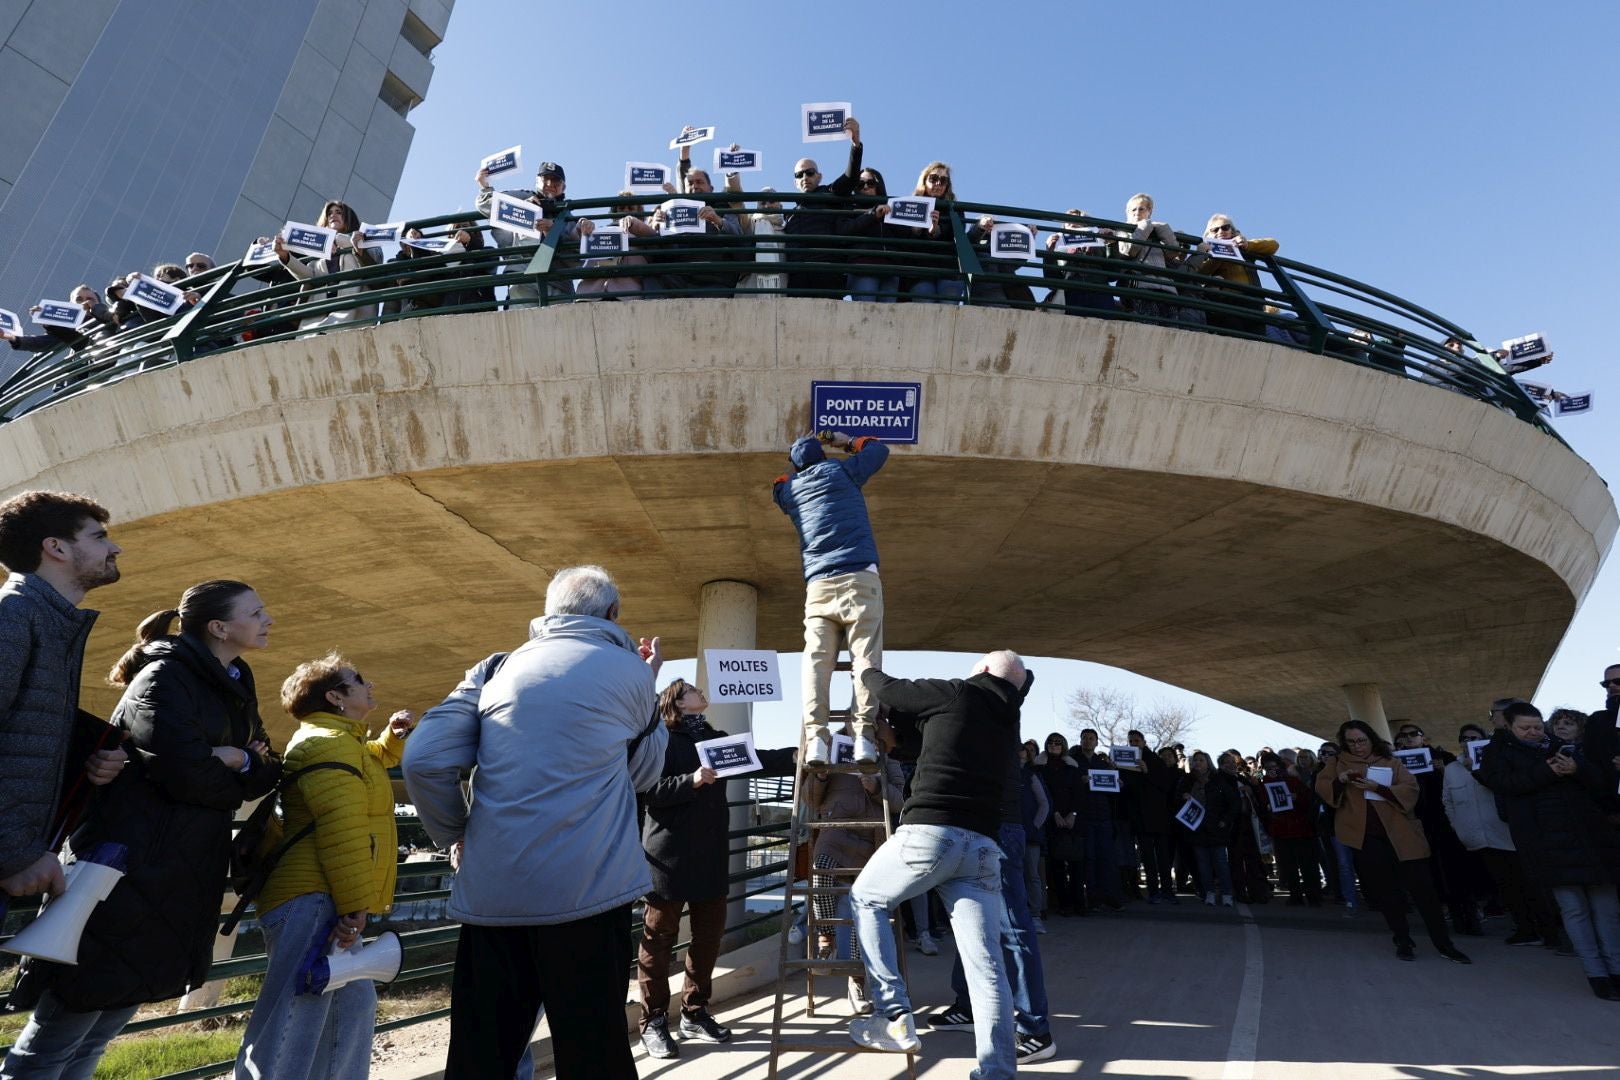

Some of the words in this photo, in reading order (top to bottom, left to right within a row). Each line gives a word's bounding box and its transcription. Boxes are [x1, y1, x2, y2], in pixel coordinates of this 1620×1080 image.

[502, 213, 532, 225] SOLIDARITAT
[292, 238, 322, 247] SOLIDARITAT
[826, 400, 863, 410] PONT
[867, 400, 884, 411] DE
[888, 401, 904, 411] LA
[819, 415, 910, 427] SOLIDARITAT
[720, 661, 768, 672] MOLTES
[719, 681, 774, 696] GRÀCIES
[715, 757, 748, 765] SOLIDARITAT
